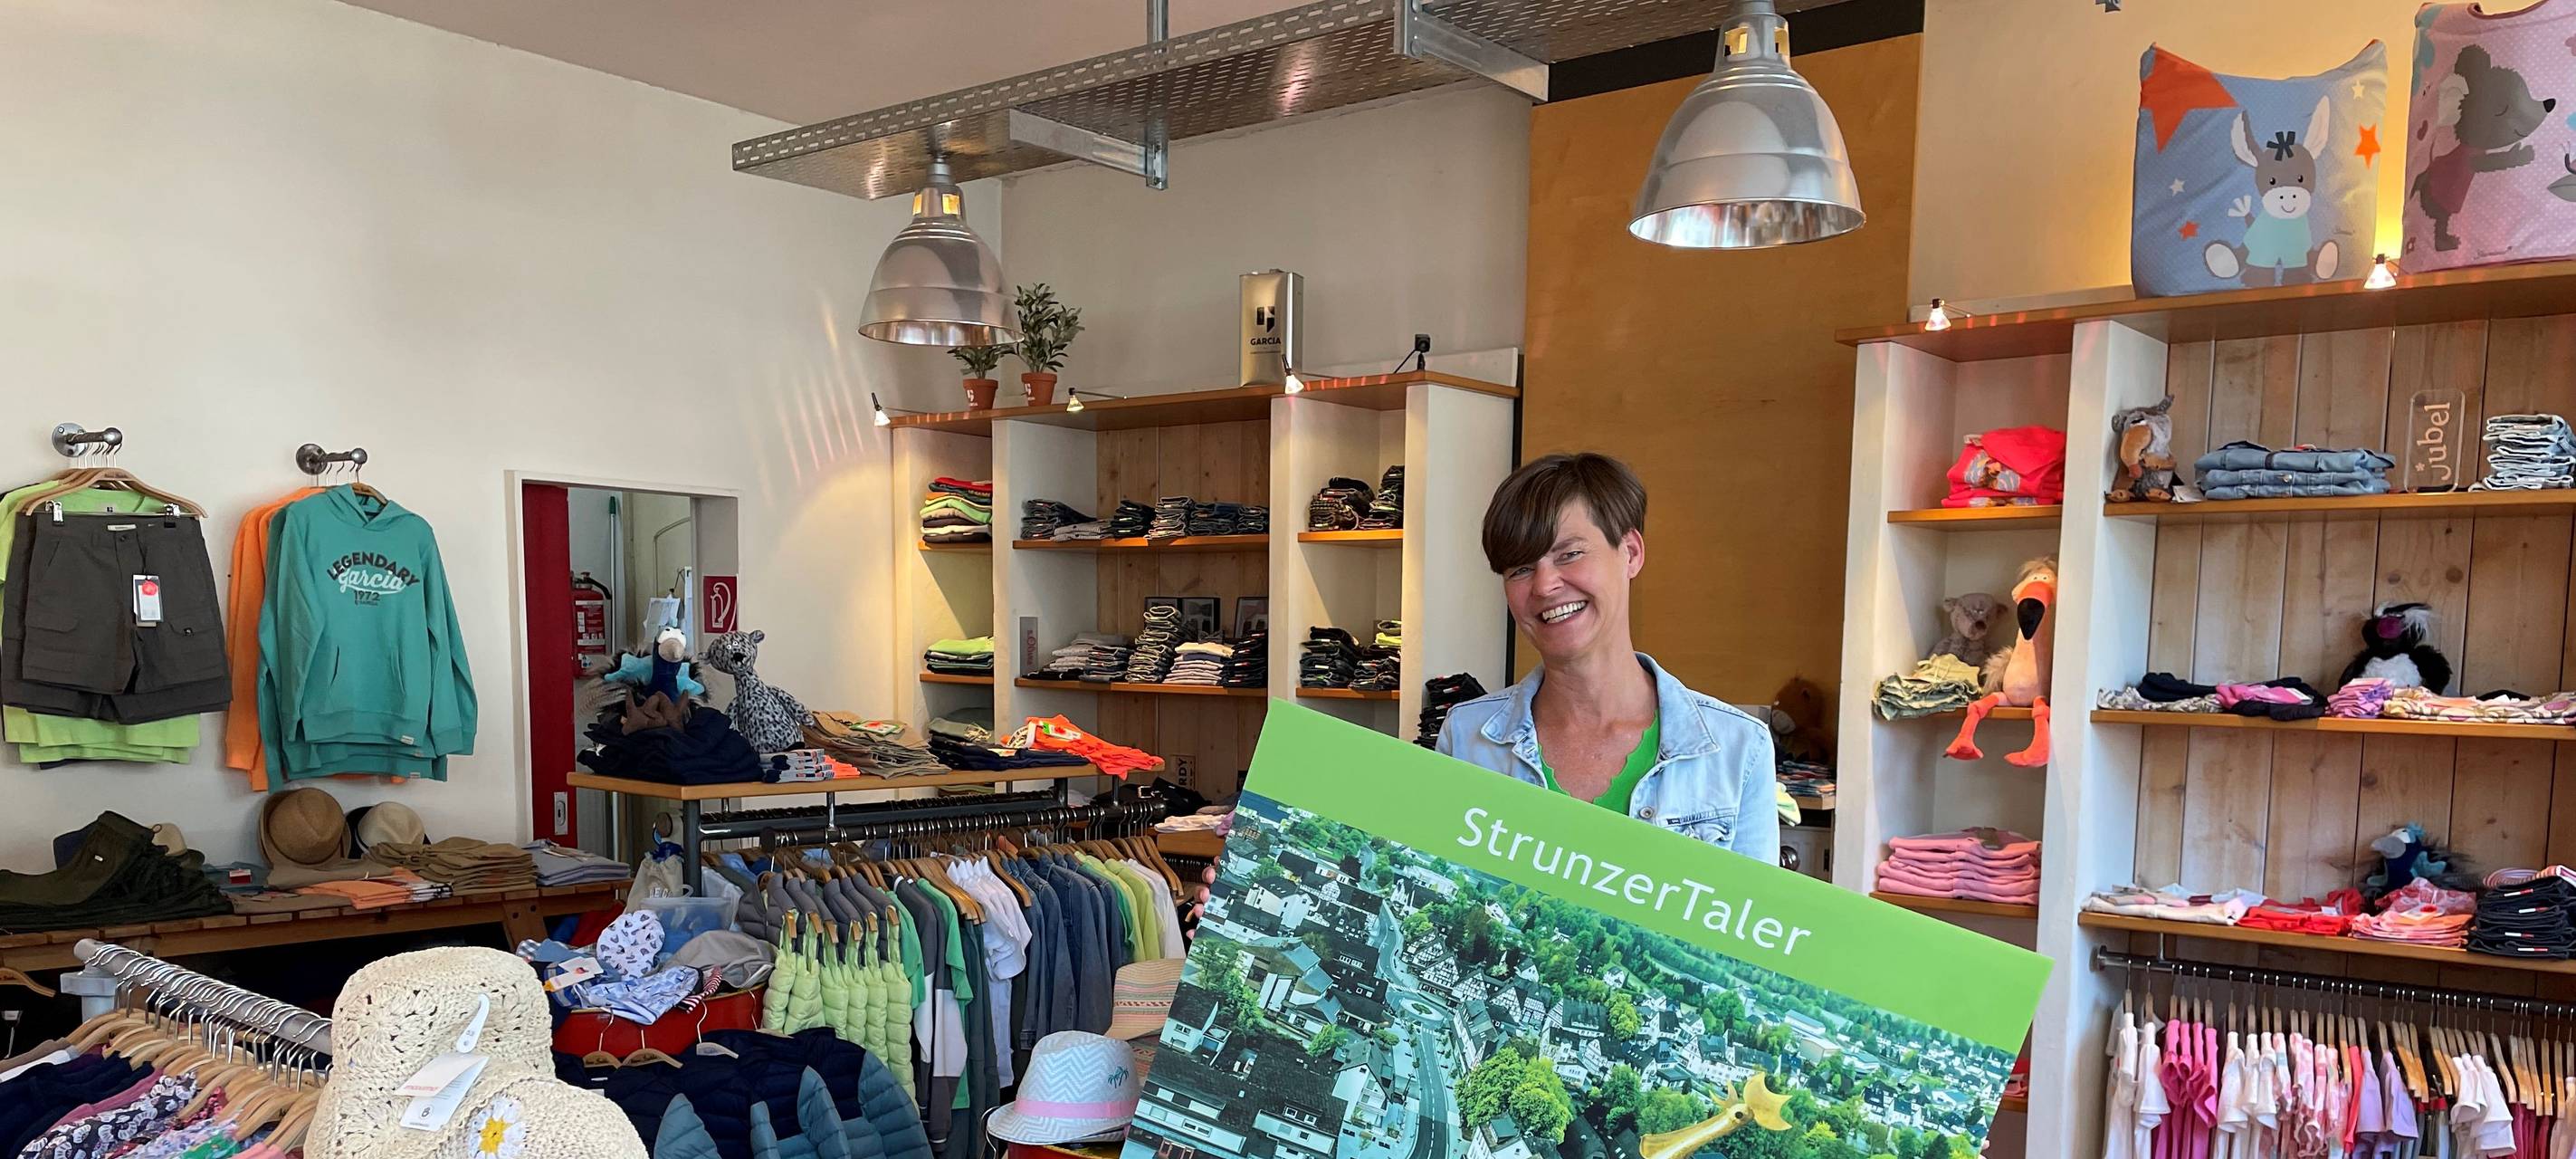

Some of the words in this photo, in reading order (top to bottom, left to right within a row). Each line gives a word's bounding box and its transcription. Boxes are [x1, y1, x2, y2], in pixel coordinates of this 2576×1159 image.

[1250, 337, 1282, 346] GARCIA
[327, 551, 420, 587] LEGENDARY
[354, 589, 381, 601] 1972
[1455, 807, 1812, 956] StrunzerTaler
